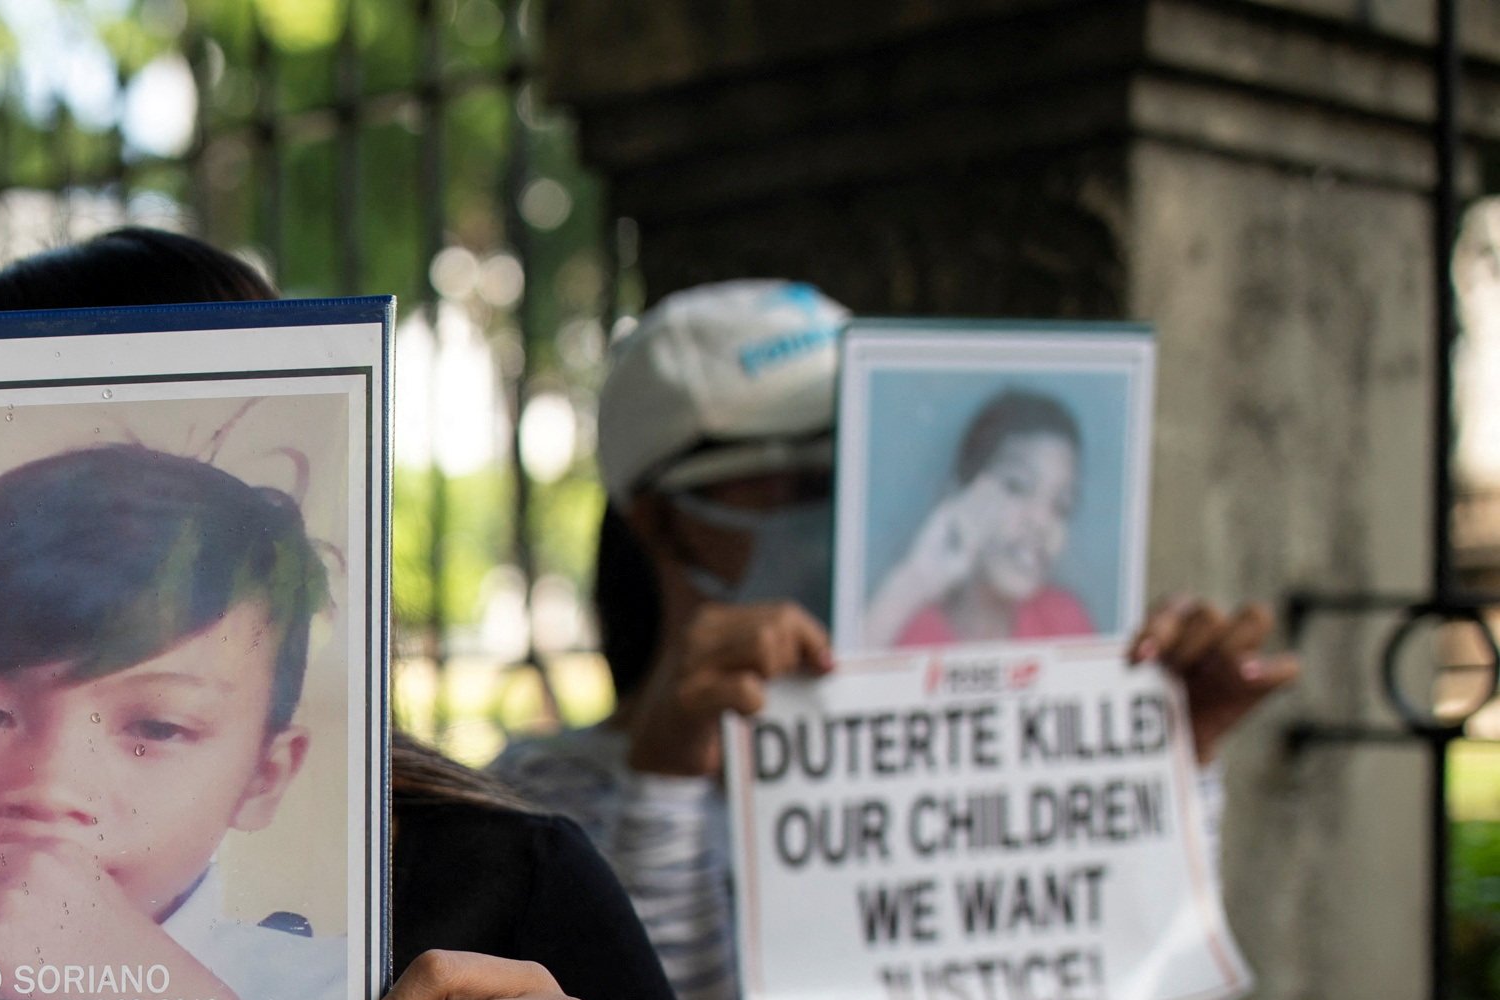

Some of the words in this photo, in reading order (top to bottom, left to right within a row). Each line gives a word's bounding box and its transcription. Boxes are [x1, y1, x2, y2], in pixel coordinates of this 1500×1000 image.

[752, 702, 1002, 783] DUTERTE
[774, 799, 892, 869] OUR
[857, 878, 938, 947] WE
[956, 863, 1108, 937] WANT
[13, 964, 170, 994] SORIANO
